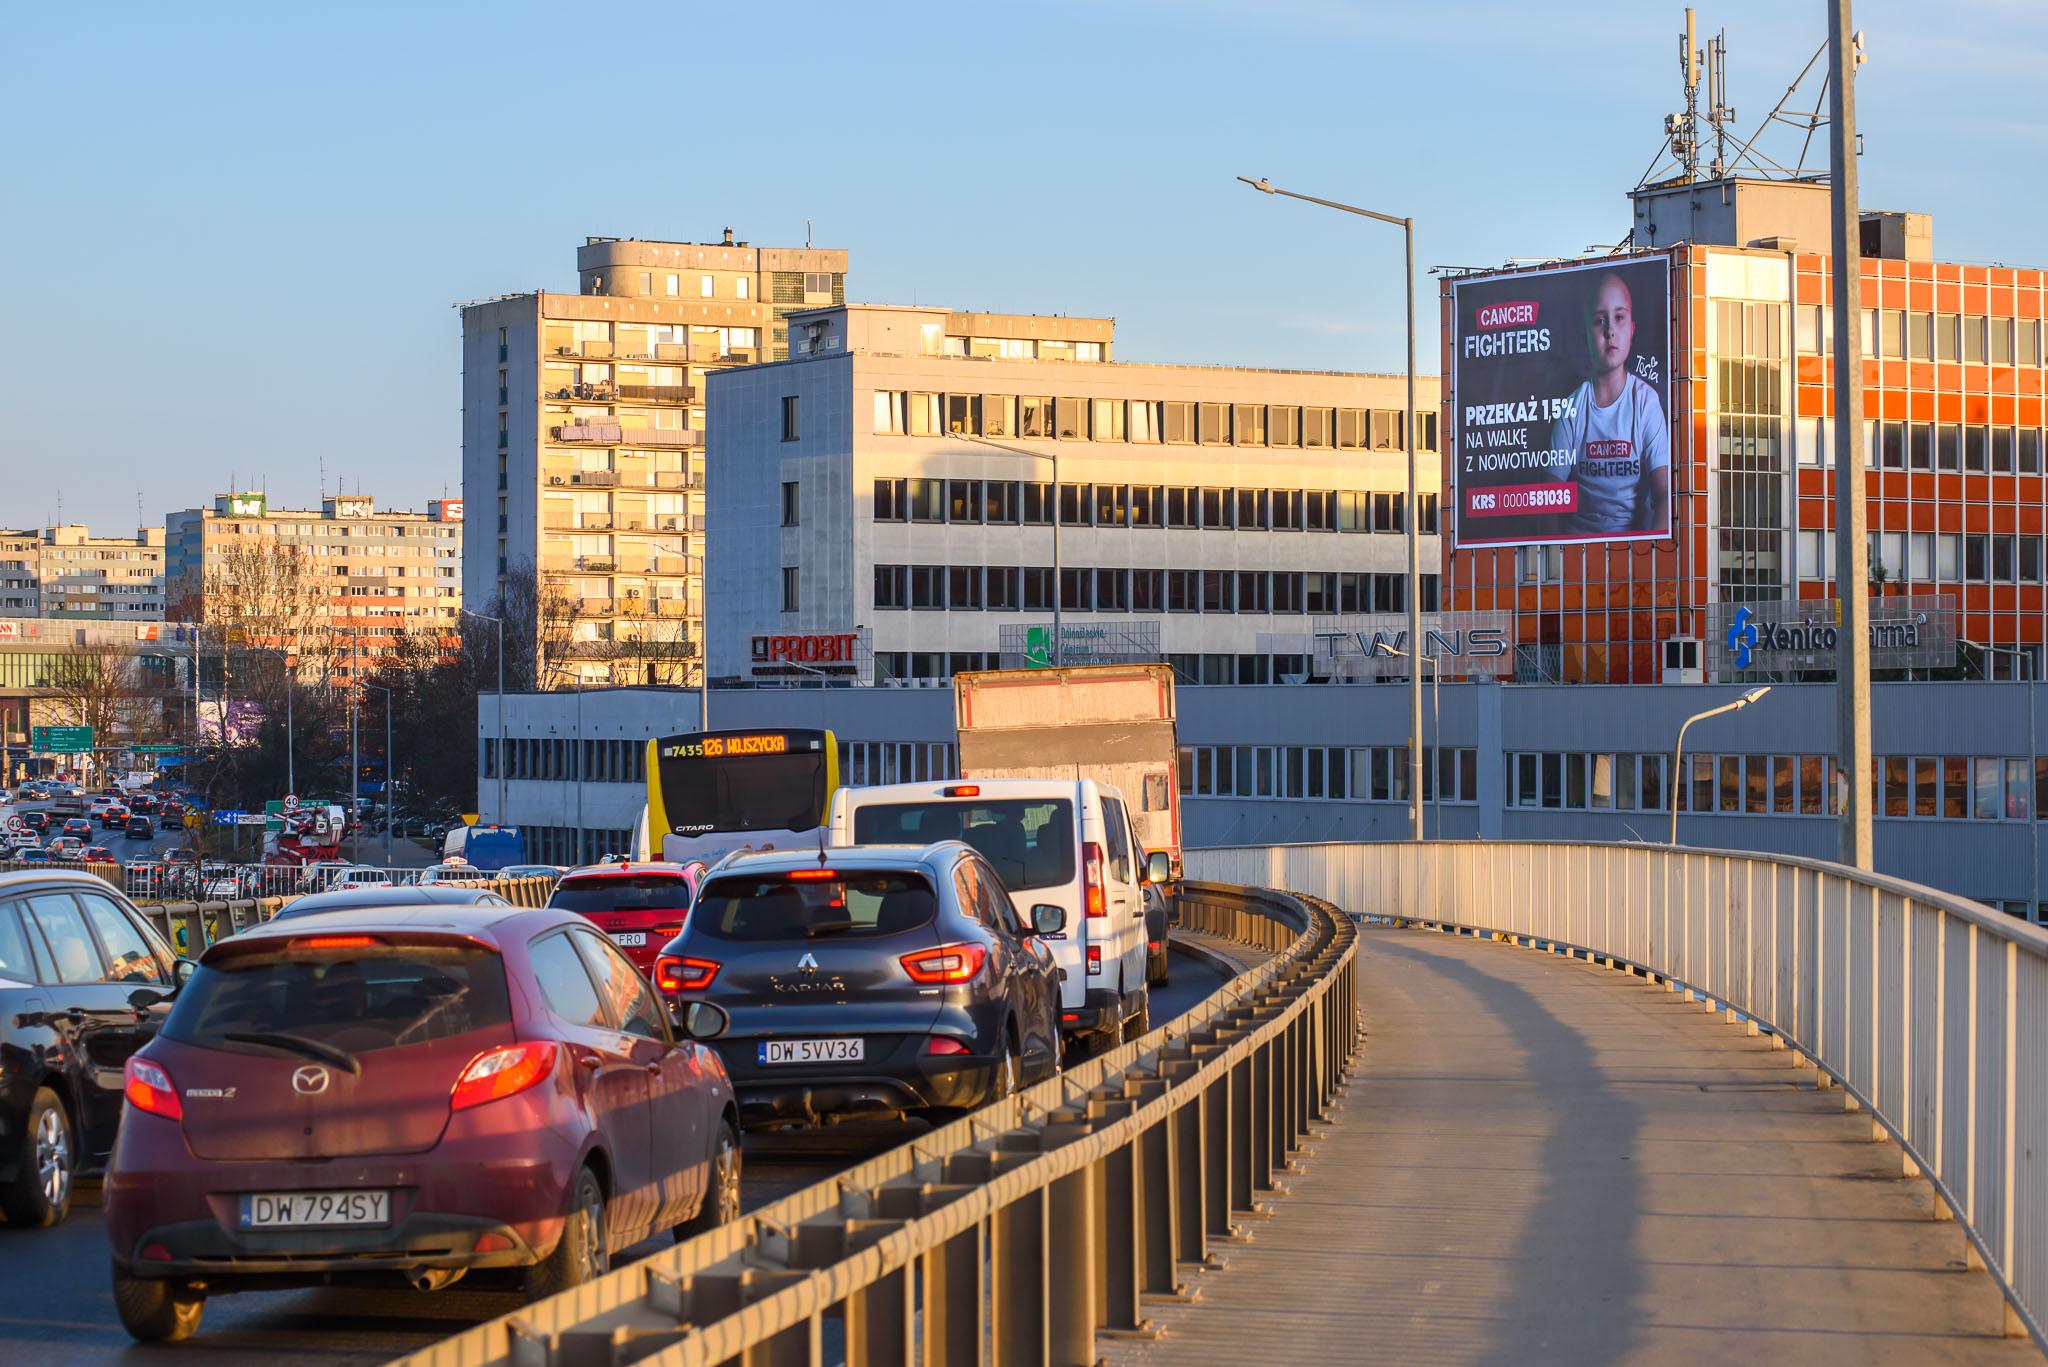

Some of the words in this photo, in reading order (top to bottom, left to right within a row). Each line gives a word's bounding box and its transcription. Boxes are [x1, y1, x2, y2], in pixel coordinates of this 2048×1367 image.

[1480, 304, 1533, 326] CANCER
[1464, 328, 1551, 359] FIGHTERS
[1465, 395, 1538, 427] PRZEKAŻ
[1541, 397, 1578, 424] 1,5%
[1465, 431, 1484, 449] NA
[1487, 427, 1528, 449] WALKĘ
[1589, 442, 1628, 456] CANCER
[1465, 455, 1473, 473] Z
[1478, 448, 1577, 472] NOWOTWOREM
[1580, 459, 1640, 477] FIGHTERS
[1472, 494, 1496, 510] KRS
[1503, 488, 1571, 508] 0000581036
[769, 633, 858, 663] PROBIT
[1314, 629, 1507, 659] TWNS
[672, 744, 704, 758] 7435
[702, 737, 723, 756] 126
[726, 735, 786, 754] WOJSZYCKA
[285, 795, 299, 806] 40
[9, 819, 21, 827] 40
[675, 823, 714, 832] CITARO
[770, 1042, 794, 1061] DW
[801, 1040, 859, 1060] 5VV36
[256, 1198, 294, 1224] DW
[303, 1194, 384, 1223] 794SY
